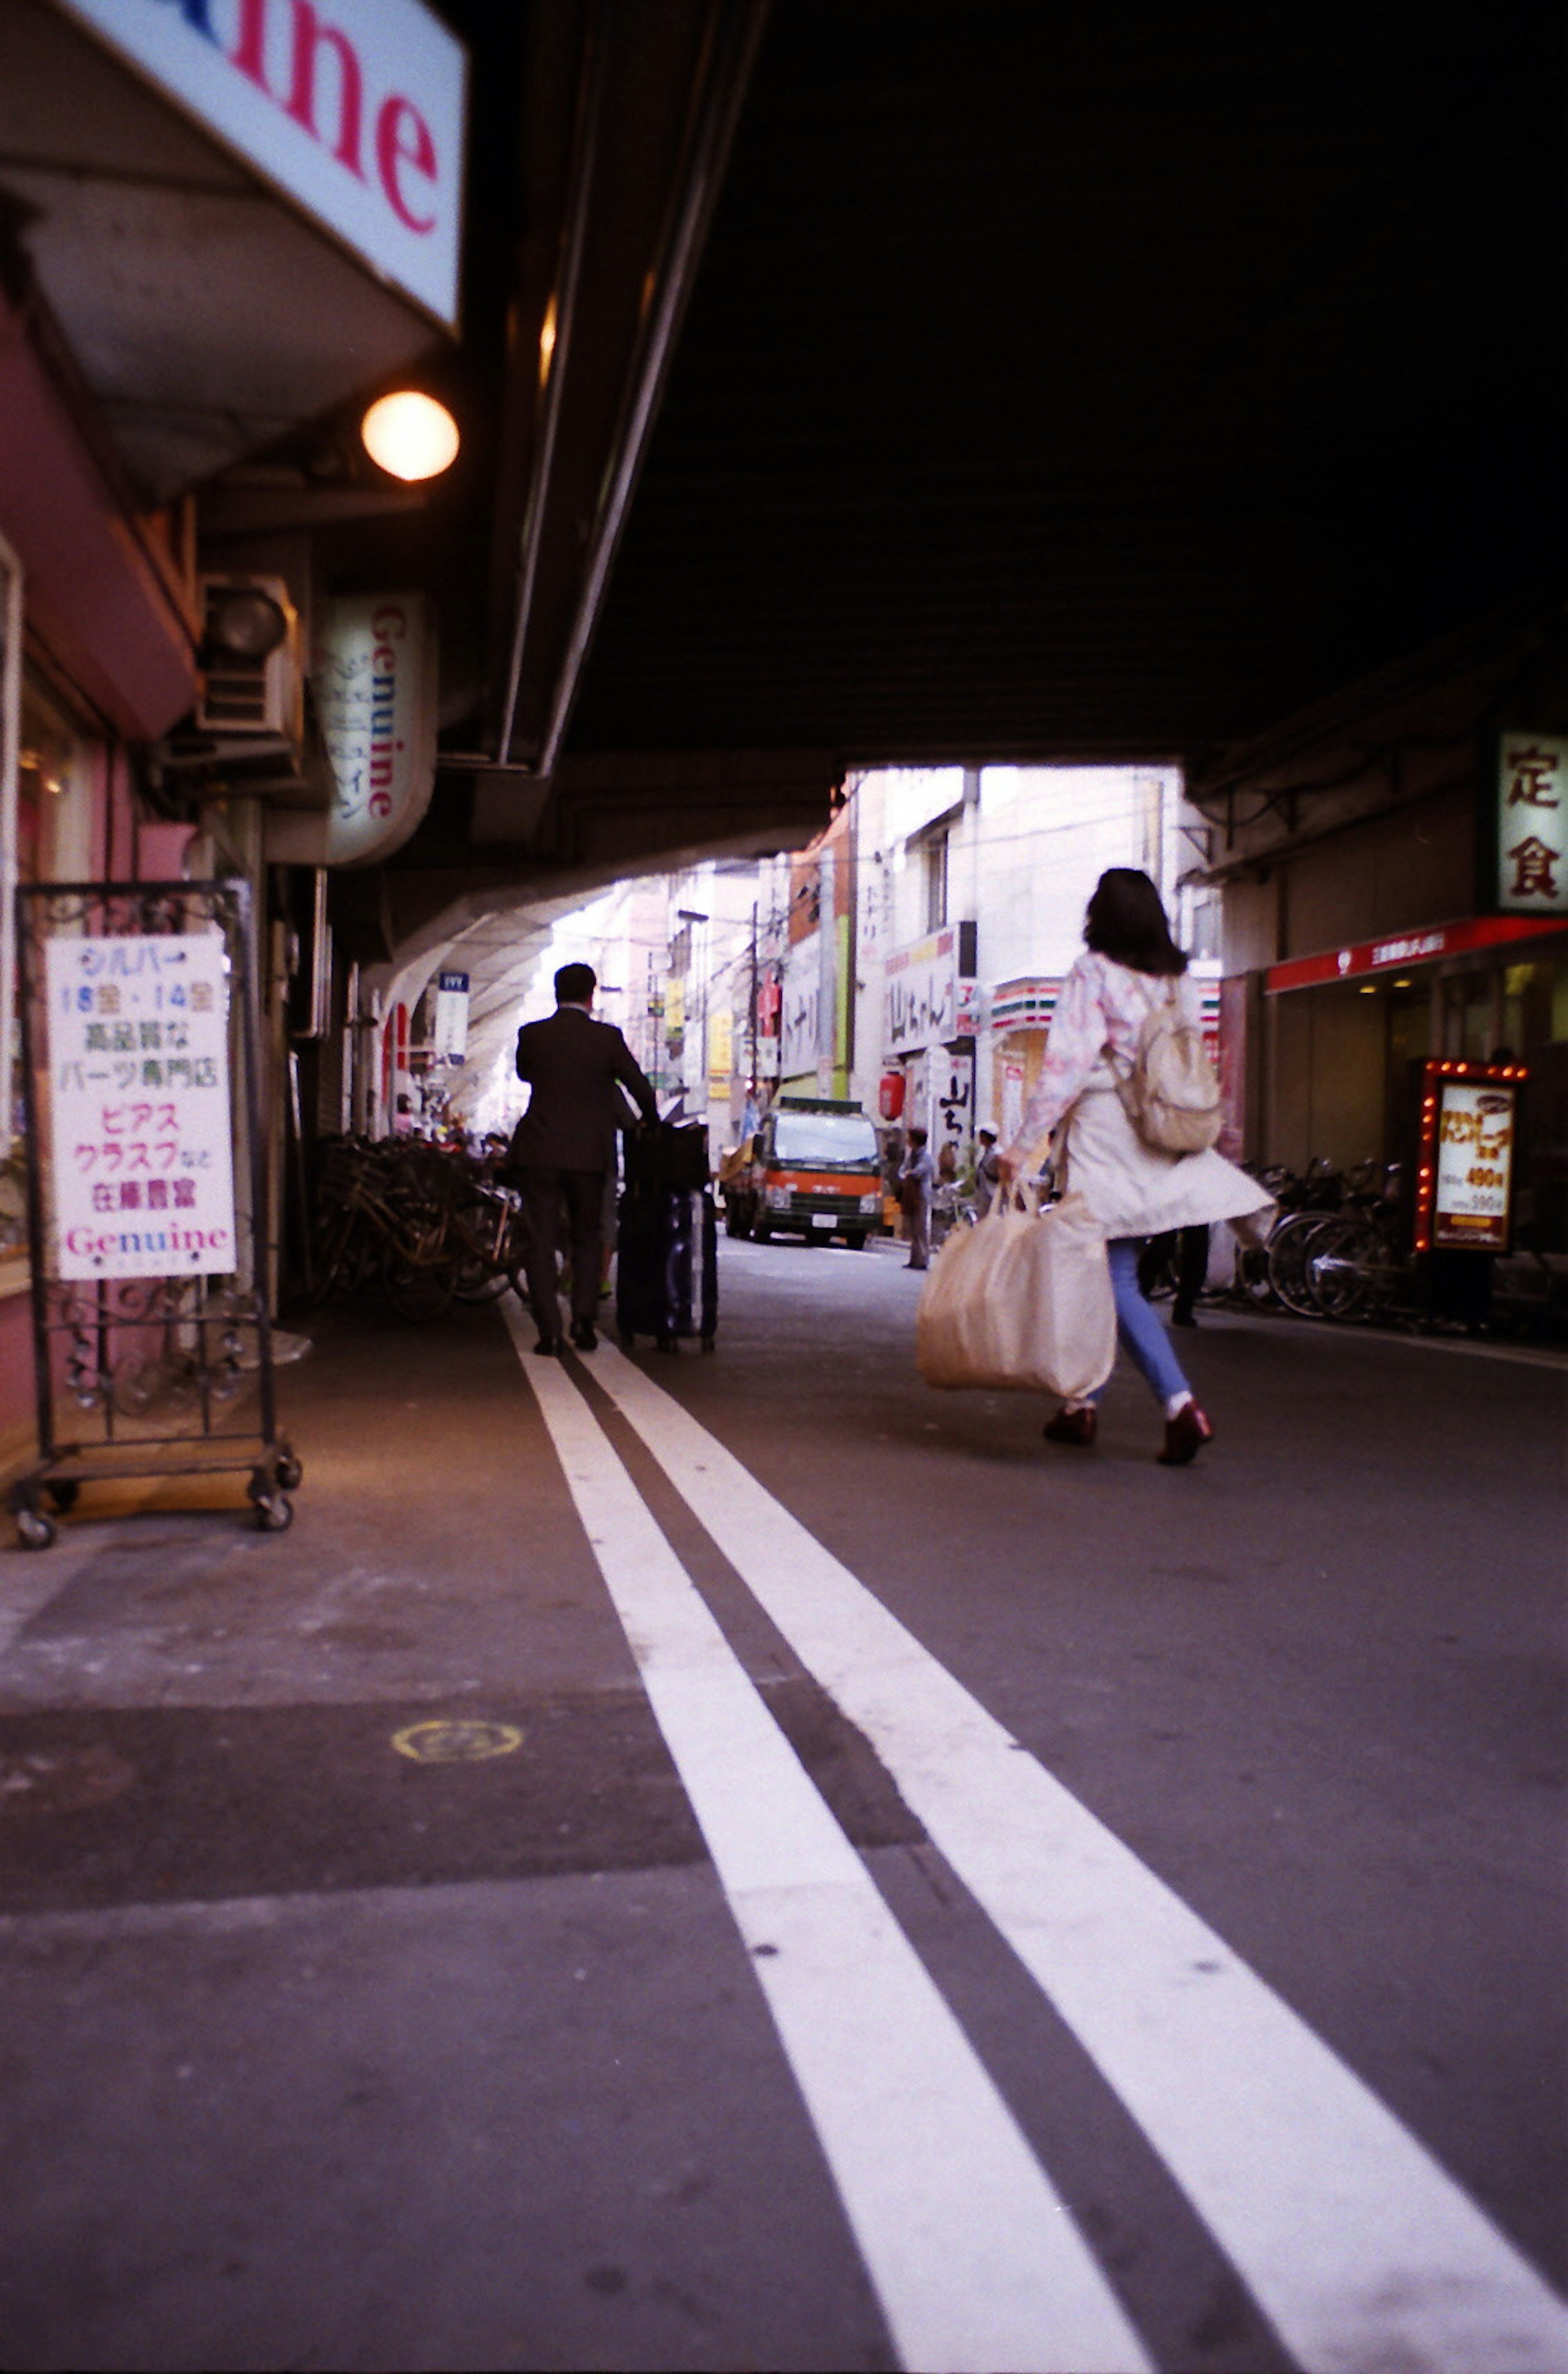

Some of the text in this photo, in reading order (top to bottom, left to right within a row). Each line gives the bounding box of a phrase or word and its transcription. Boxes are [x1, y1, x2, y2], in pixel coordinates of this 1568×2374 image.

[174, 0, 439, 234] ine
[368, 604, 407, 818] Genuine
[1507, 746, 1560, 899] 定食
[60, 1057, 218, 1092] パーツ専門店
[102, 1103, 180, 1135] ピアス
[93, 1178, 196, 1212] 在庫豊富
[67, 1223, 227, 1255] Genuine
